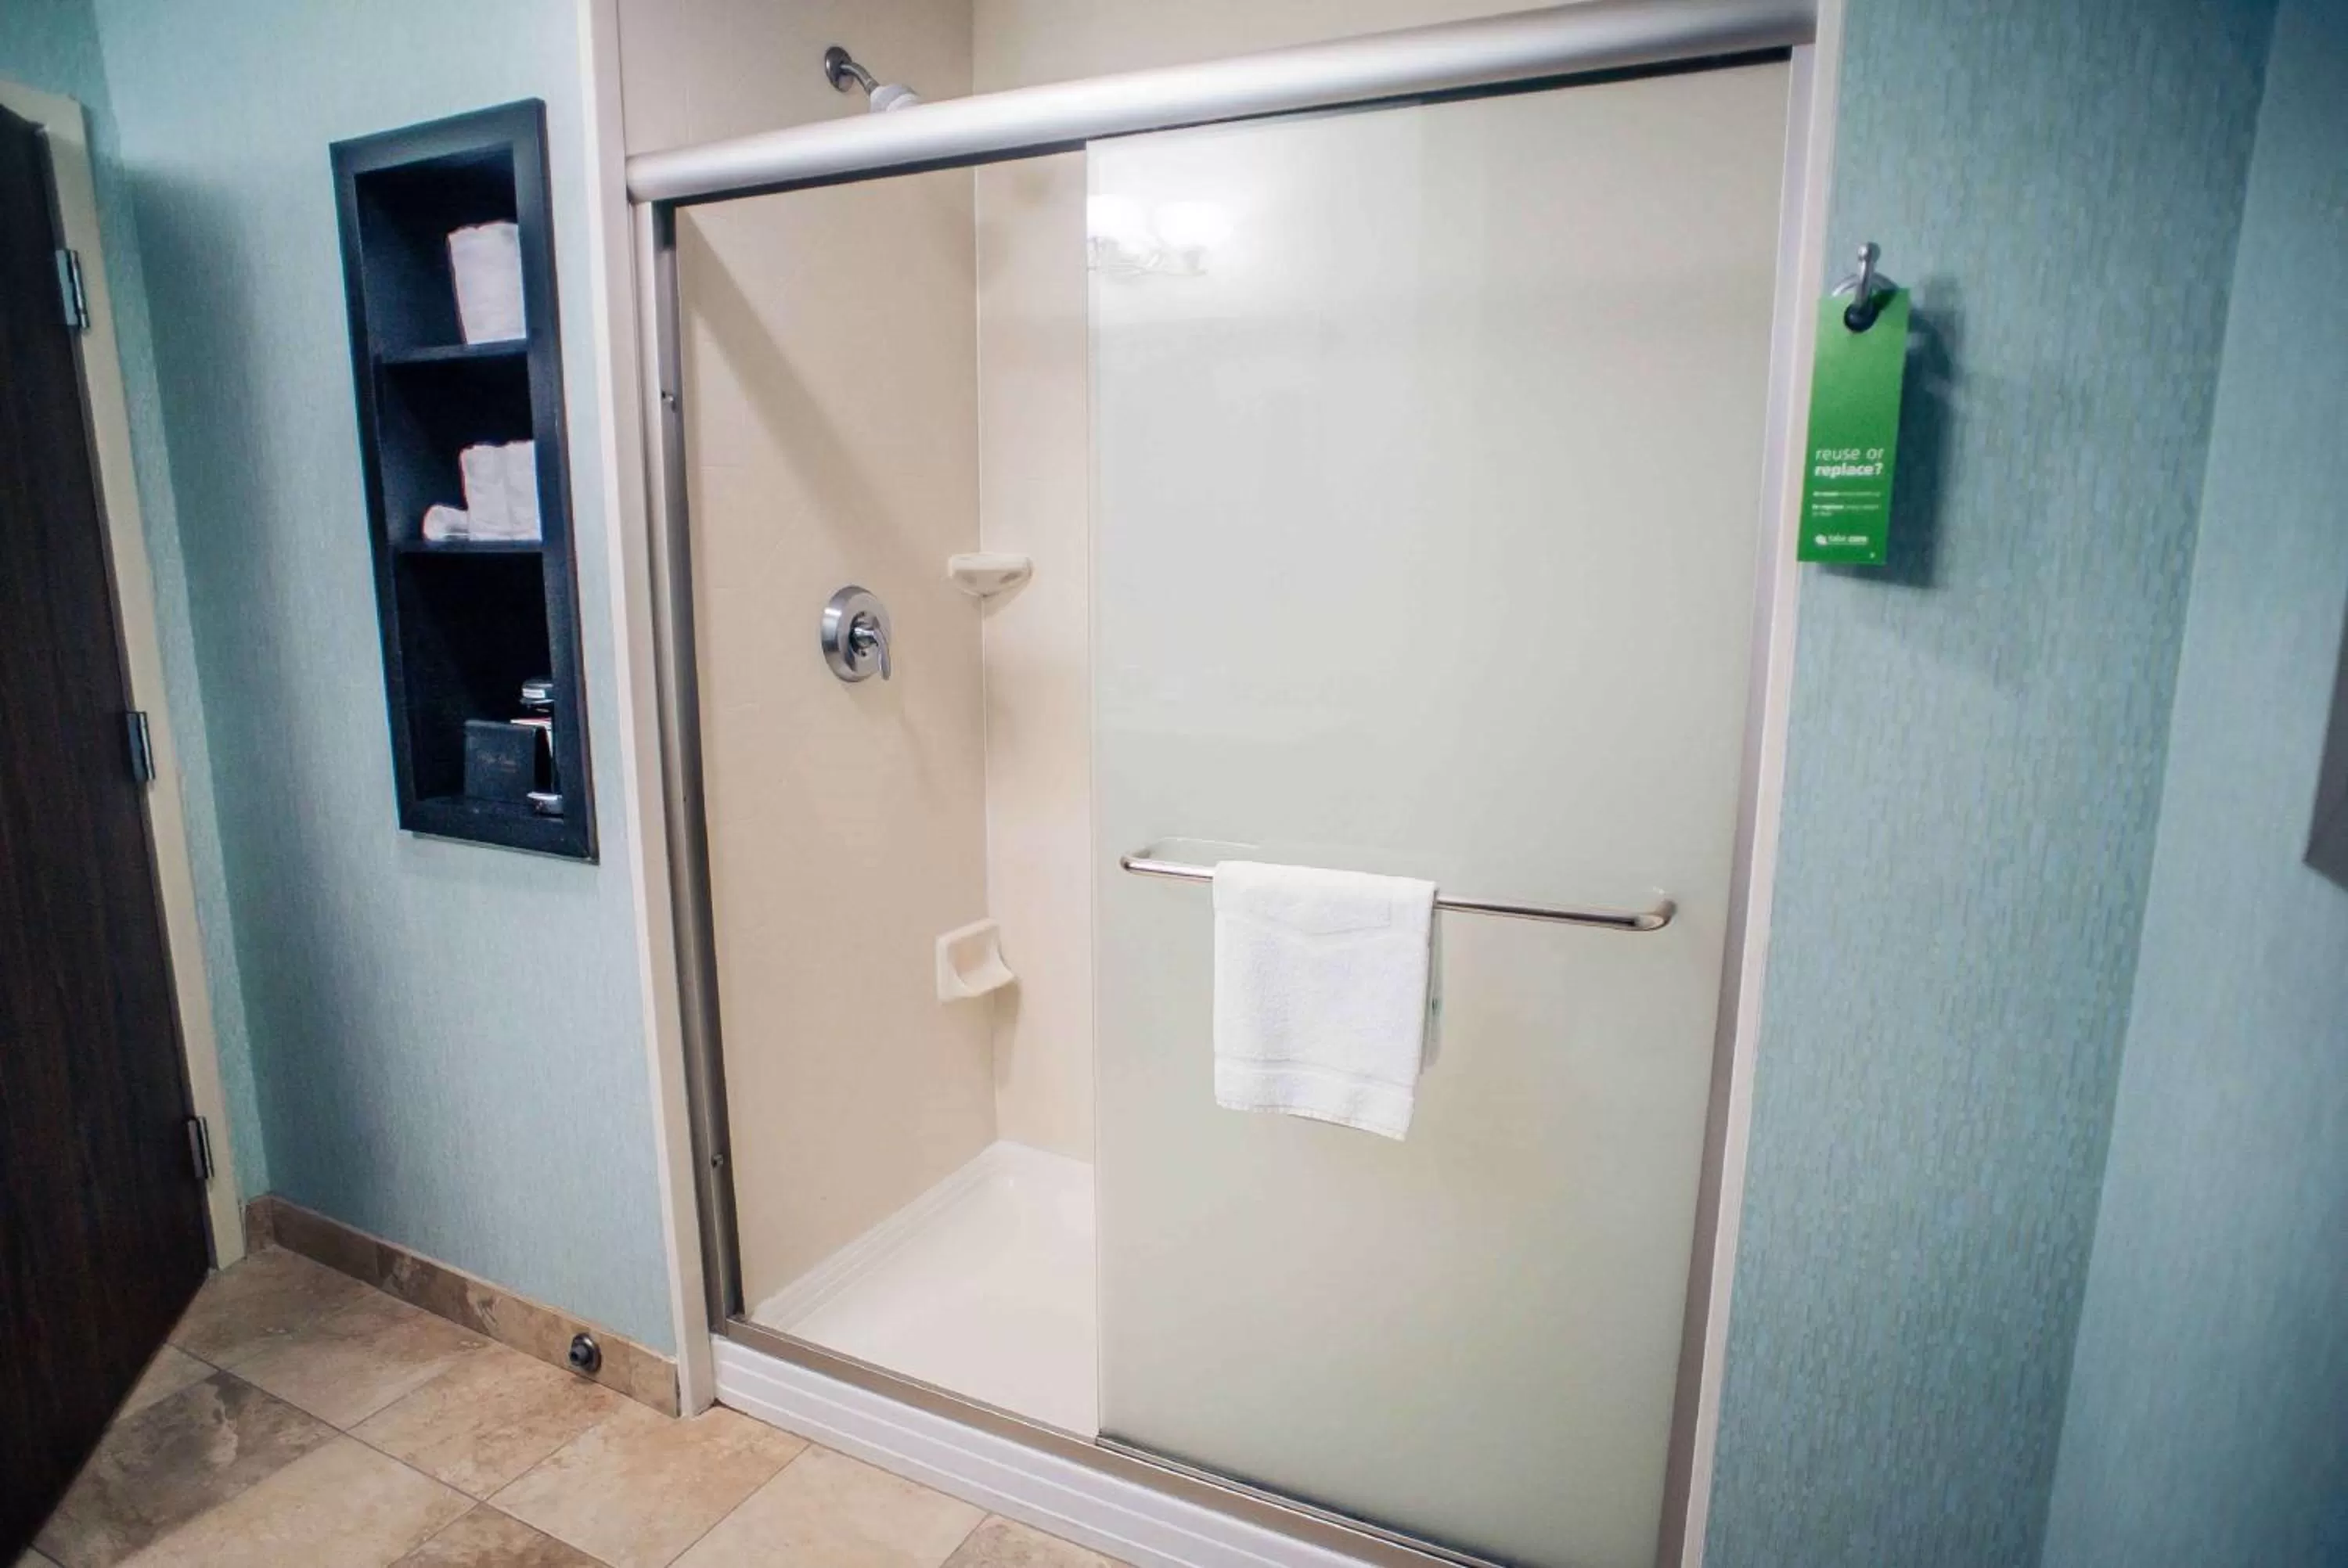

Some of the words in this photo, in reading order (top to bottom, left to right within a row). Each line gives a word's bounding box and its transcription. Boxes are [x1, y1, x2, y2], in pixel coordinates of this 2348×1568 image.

[1815, 448, 1860, 461] reuse
[1866, 447, 1885, 460] or
[1813, 462, 1884, 479] replace?
